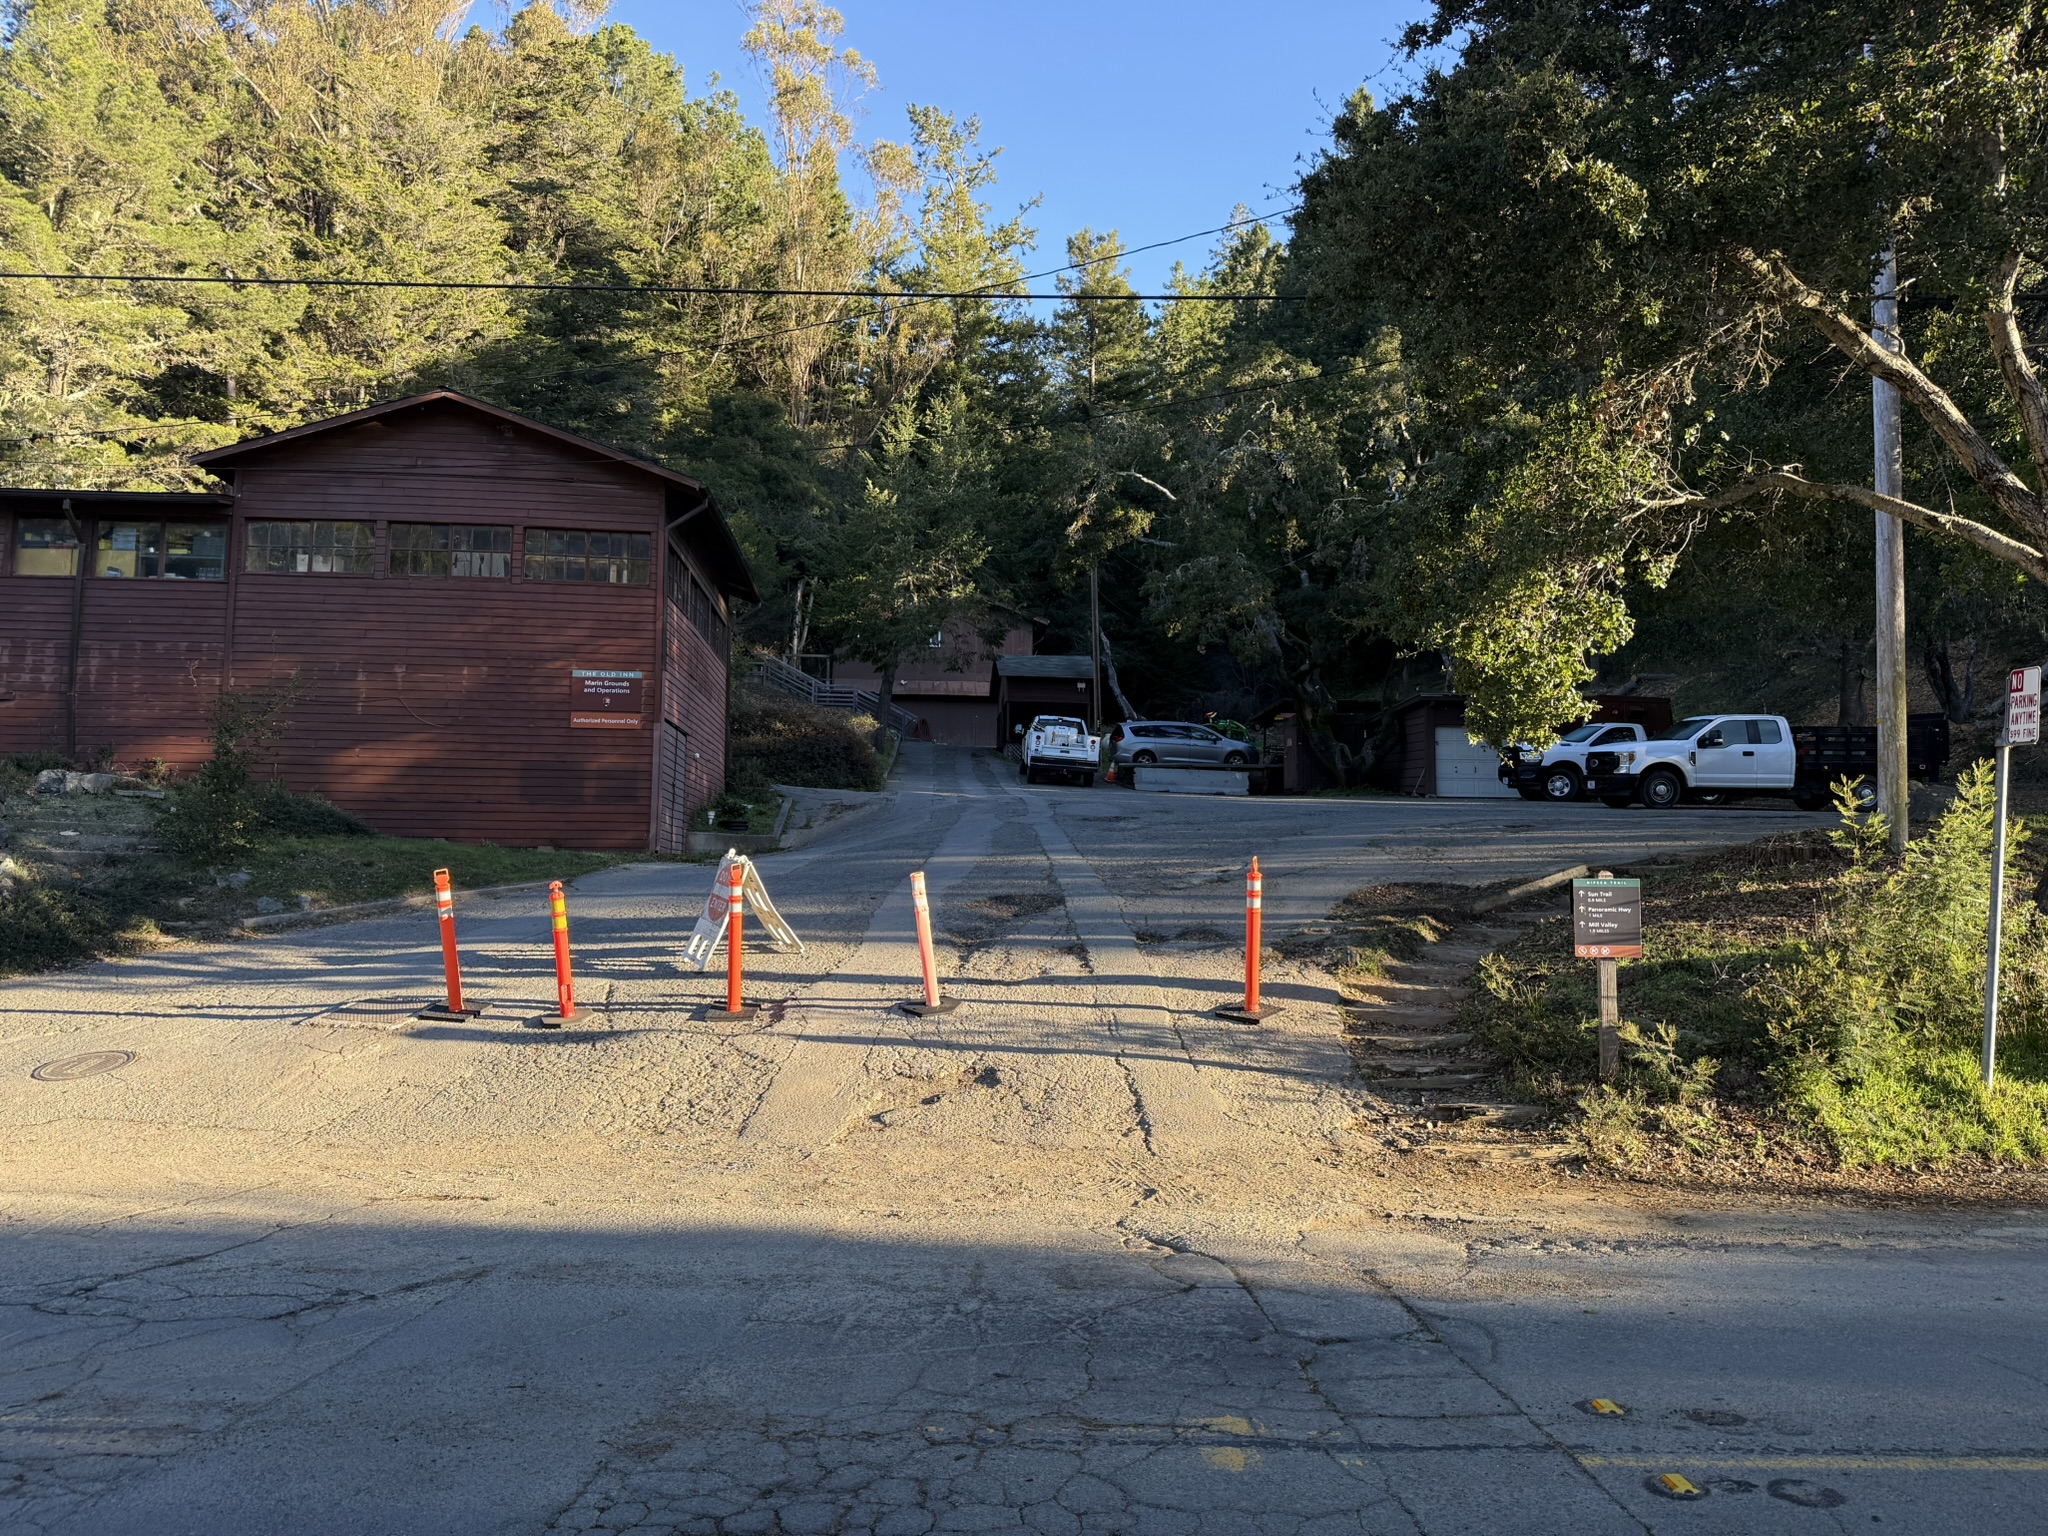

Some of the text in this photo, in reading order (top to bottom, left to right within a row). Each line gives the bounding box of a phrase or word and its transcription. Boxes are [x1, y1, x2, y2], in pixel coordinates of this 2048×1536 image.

[2011, 673, 2023, 690] NO
[2010, 693, 2037, 709] PARKING
[2010, 710, 2036, 726] ANYTIME
[2022, 728, 2036, 738] FINE
[710, 897, 727, 913] ENTER
